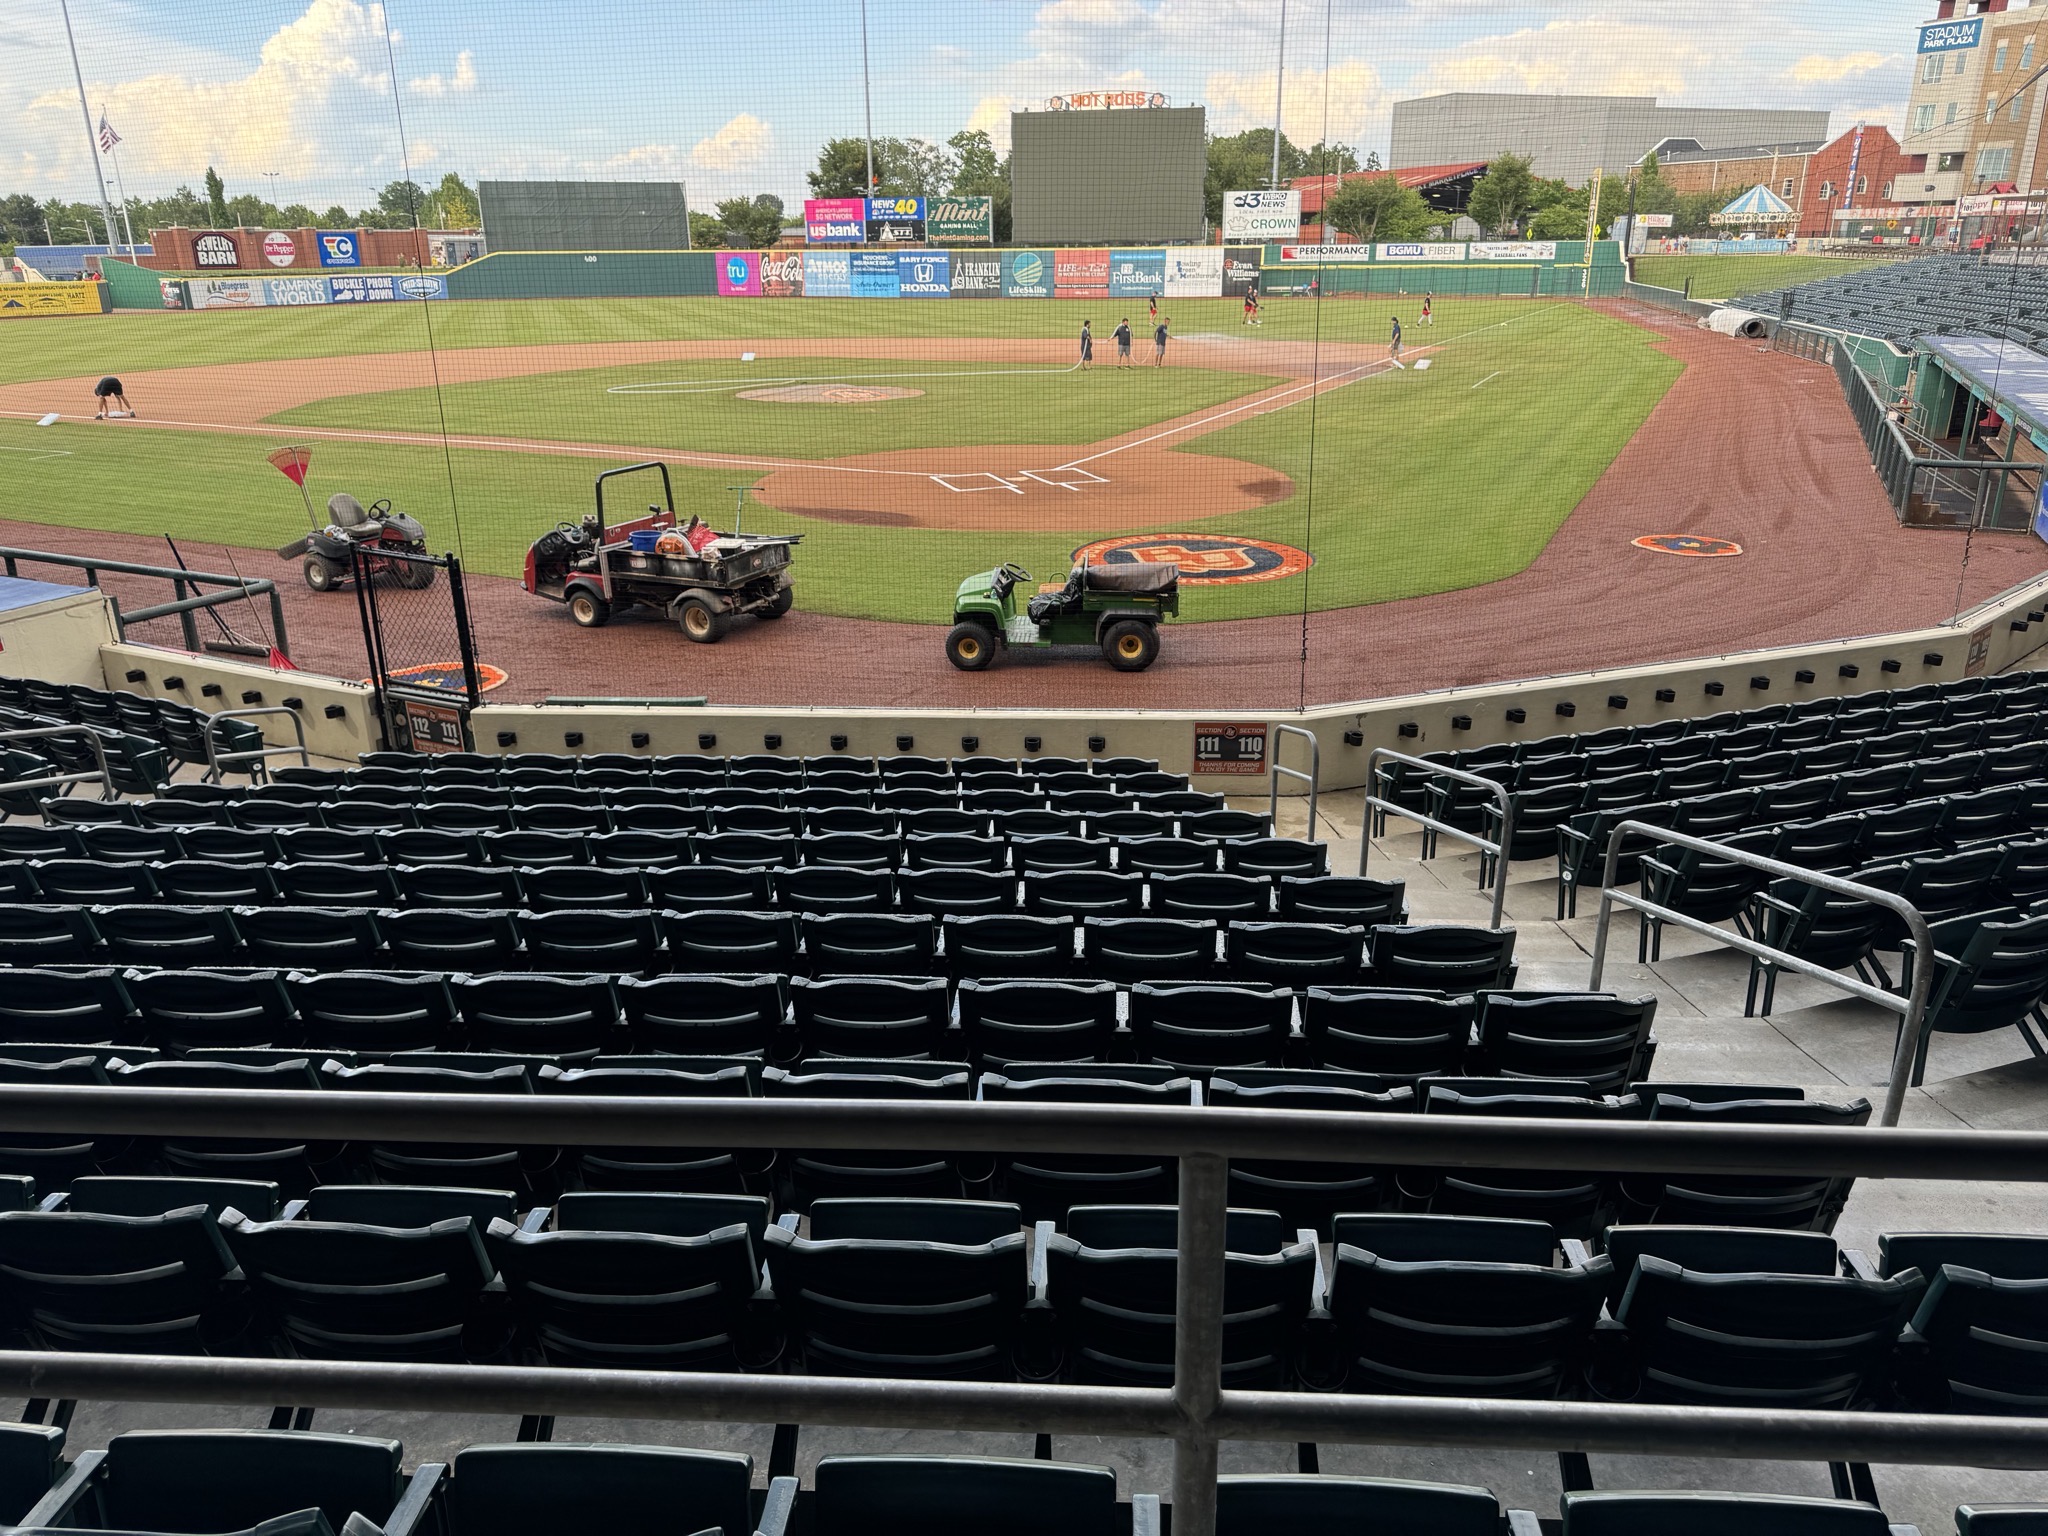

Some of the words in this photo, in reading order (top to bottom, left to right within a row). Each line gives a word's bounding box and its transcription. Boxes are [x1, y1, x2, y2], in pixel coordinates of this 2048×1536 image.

[1925, 23, 1976, 41] STADIUM
[1923, 39, 1945, 49] PARK
[1946, 35, 1973, 46] PLAZA
[1070, 93, 1101, 108] HOT
[1104, 91, 1146, 106] RODS
[1244, 193, 1261, 208] 13
[1263, 192, 1287, 200] WBKO
[872, 199, 895, 209] NEWS
[894, 199, 918, 215] 40
[934, 202, 989, 222] Mint
[1251, 219, 1297, 229] CROWN
[810, 223, 862, 238] usbank
[197, 235, 233, 252] JEWELRY
[928, 234, 989, 243] TheMintGaming.com
[273, 244, 294, 254] Pepper
[1299, 246, 1369, 255] PERFORMANCE
[1389, 246, 1421, 255] BGMU
[1428, 246, 1456, 255] FIBER
[200, 251, 238, 265] BARN
[727, 263, 745, 278] tru
[761, 256, 802, 283] Coca-Cola
[807, 259, 848, 274] ATMOS
[965, 262, 1001, 276] FRANKLIN
[1058, 263, 1077, 272] LIFE
[1233, 261, 1253, 269] Evan
[818, 273, 848, 282] energy
[1227, 269, 1260, 278] Williams
[221, 282, 249, 291] Bluegrass
[271, 279, 324, 291] CAMPING
[332, 278, 364, 290] BUCKLE
[367, 277, 394, 288] PHONE
[901, 284, 949, 292] HONDA
[965, 277, 984, 289] BANK
[354, 289, 366, 300] UP
[368, 289, 395, 300] DOWN
[1009, 286, 1048, 294] LifeSkills
[272, 291, 326, 306] WORLD
[437, 712, 458, 721] SECTION
[412, 716, 430, 733] 112
[440, 721, 458, 738] 111
[1198, 736, 1220, 752] 111
[1238, 736, 1263, 752] 110
